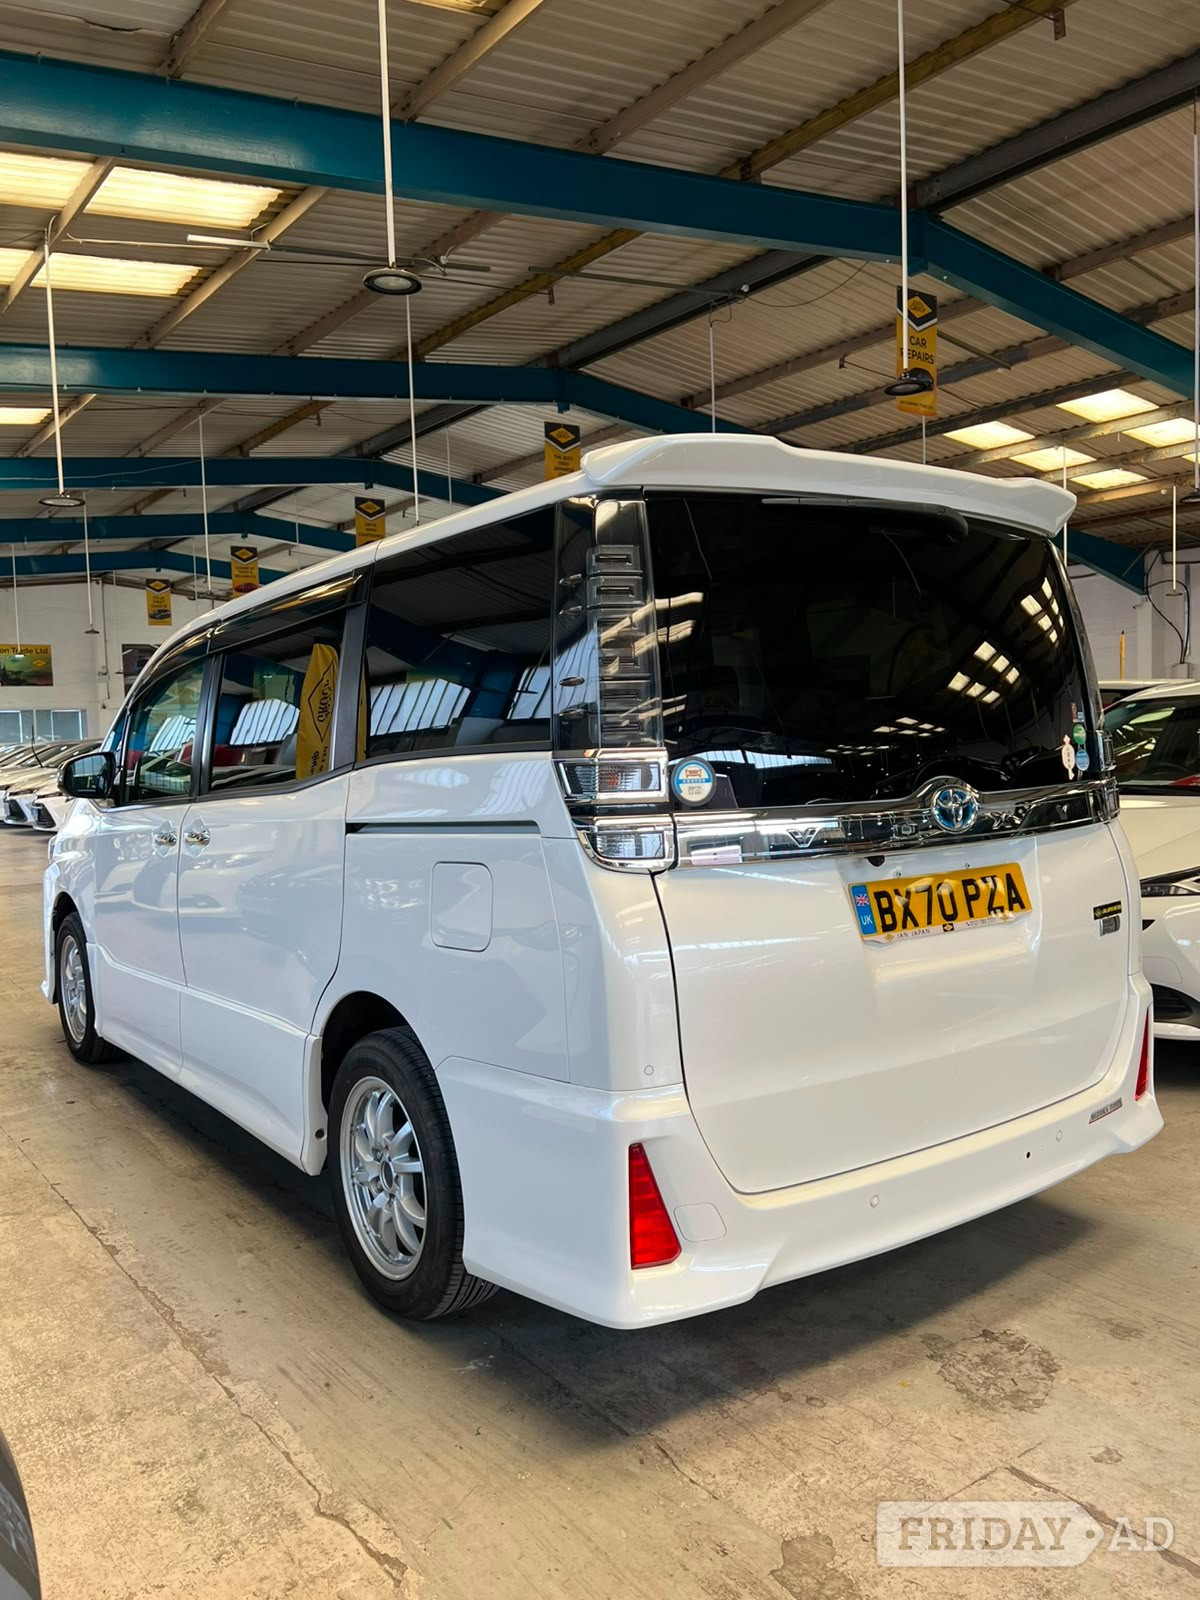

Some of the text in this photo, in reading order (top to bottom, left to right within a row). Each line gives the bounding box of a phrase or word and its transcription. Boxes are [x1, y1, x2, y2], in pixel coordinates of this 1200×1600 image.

[909, 335, 927, 349] CAR
[861, 914, 874, 925] UK
[911, 928, 931, 938] JAPAN
